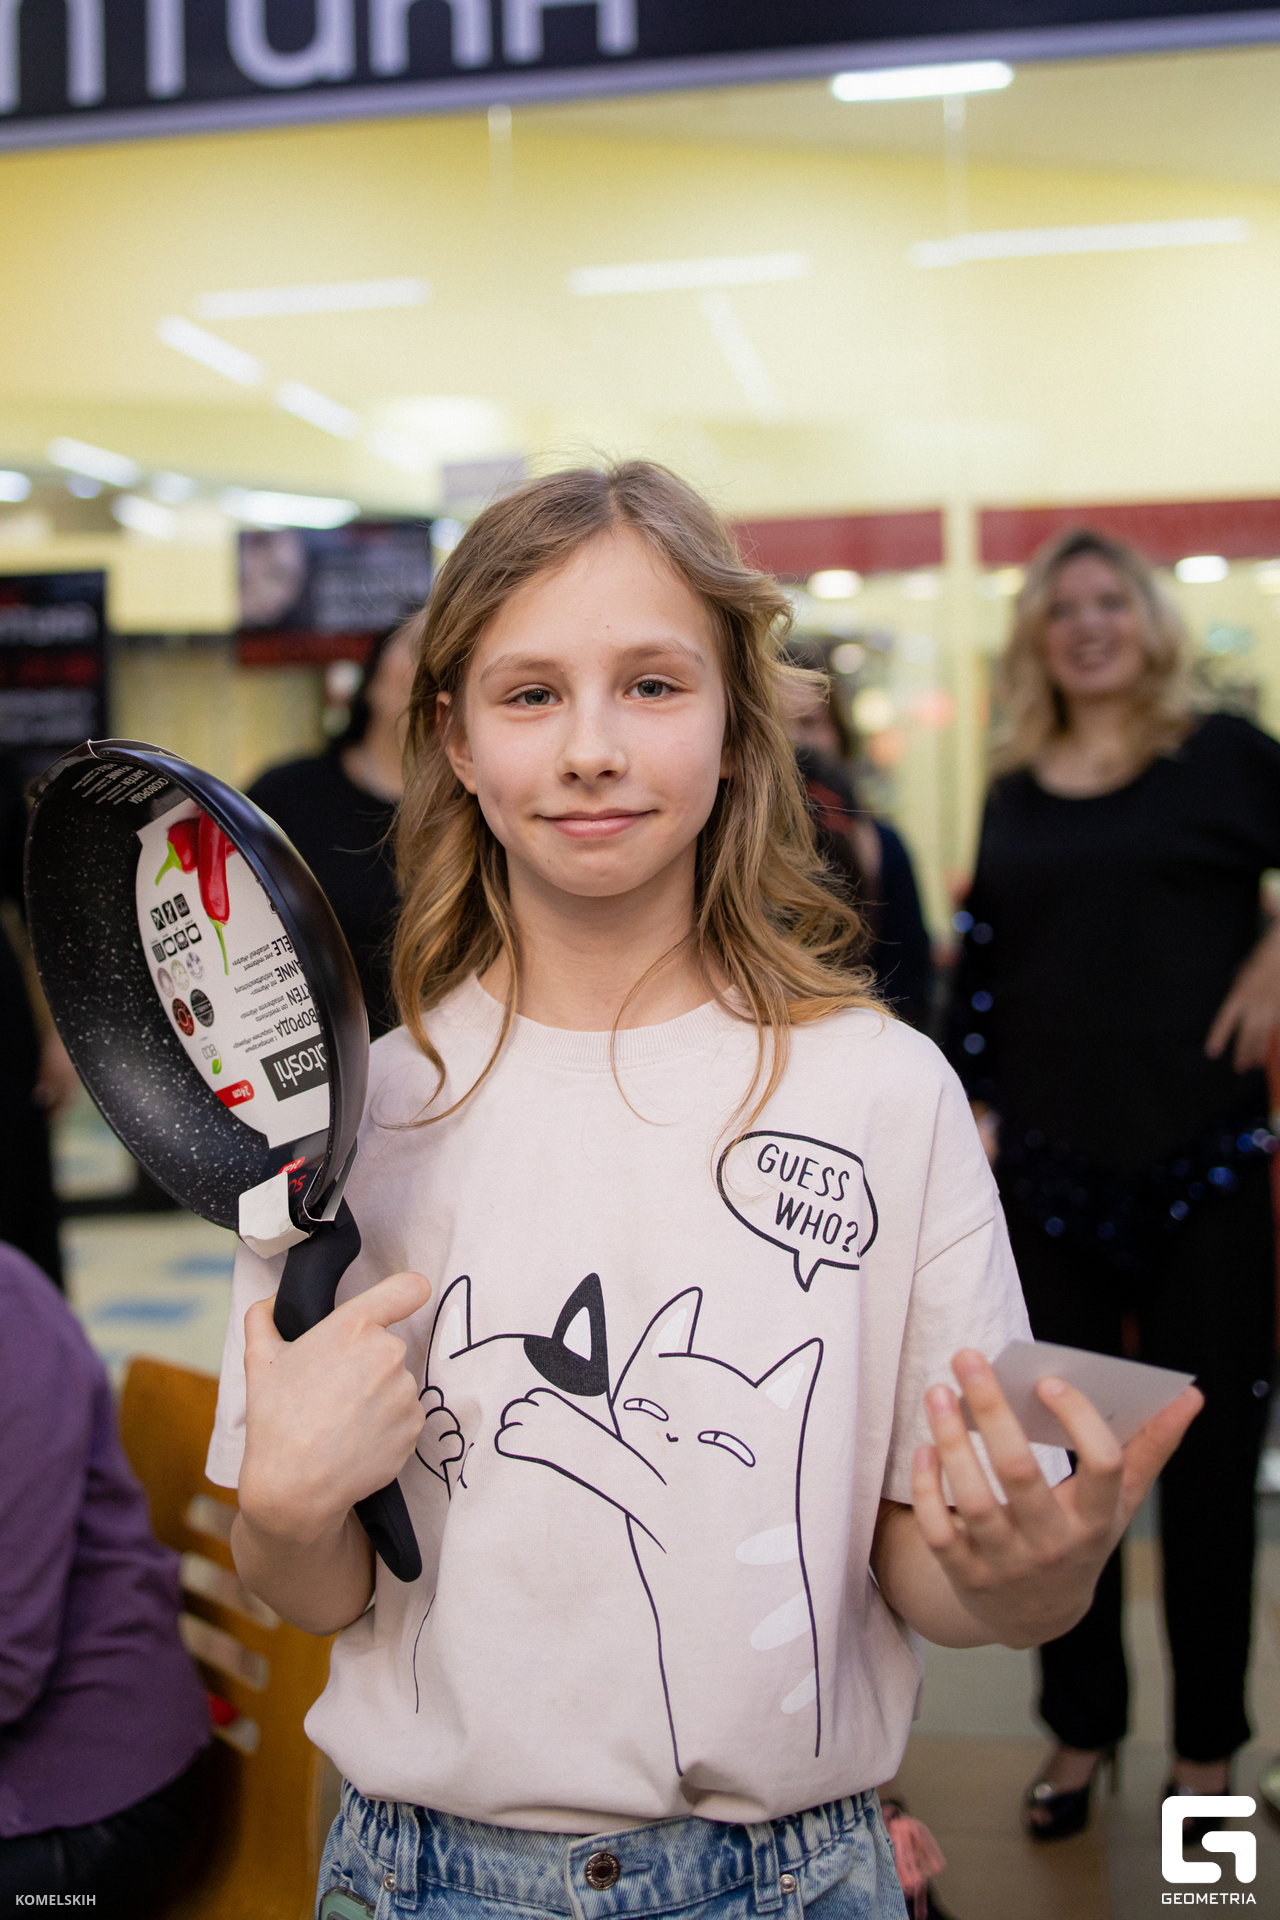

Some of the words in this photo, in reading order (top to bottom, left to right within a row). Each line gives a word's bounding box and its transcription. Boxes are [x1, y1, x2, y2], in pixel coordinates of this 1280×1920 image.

[119, 768, 148, 787] SARTÉN
[127, 777, 169, 804] СКОВОРОДА
[270, 934, 293, 956] ÊLE
[273, 957, 302, 983] ANNE
[272, 1006, 319, 1038] ВОРОДА
[200, 1043, 218, 1060] eco
[271, 1042, 327, 1088] atoshi
[230, 1084, 251, 1101] 24cm
[757, 1143, 850, 1201] GUESS
[775, 1191, 859, 1253] WHO?
